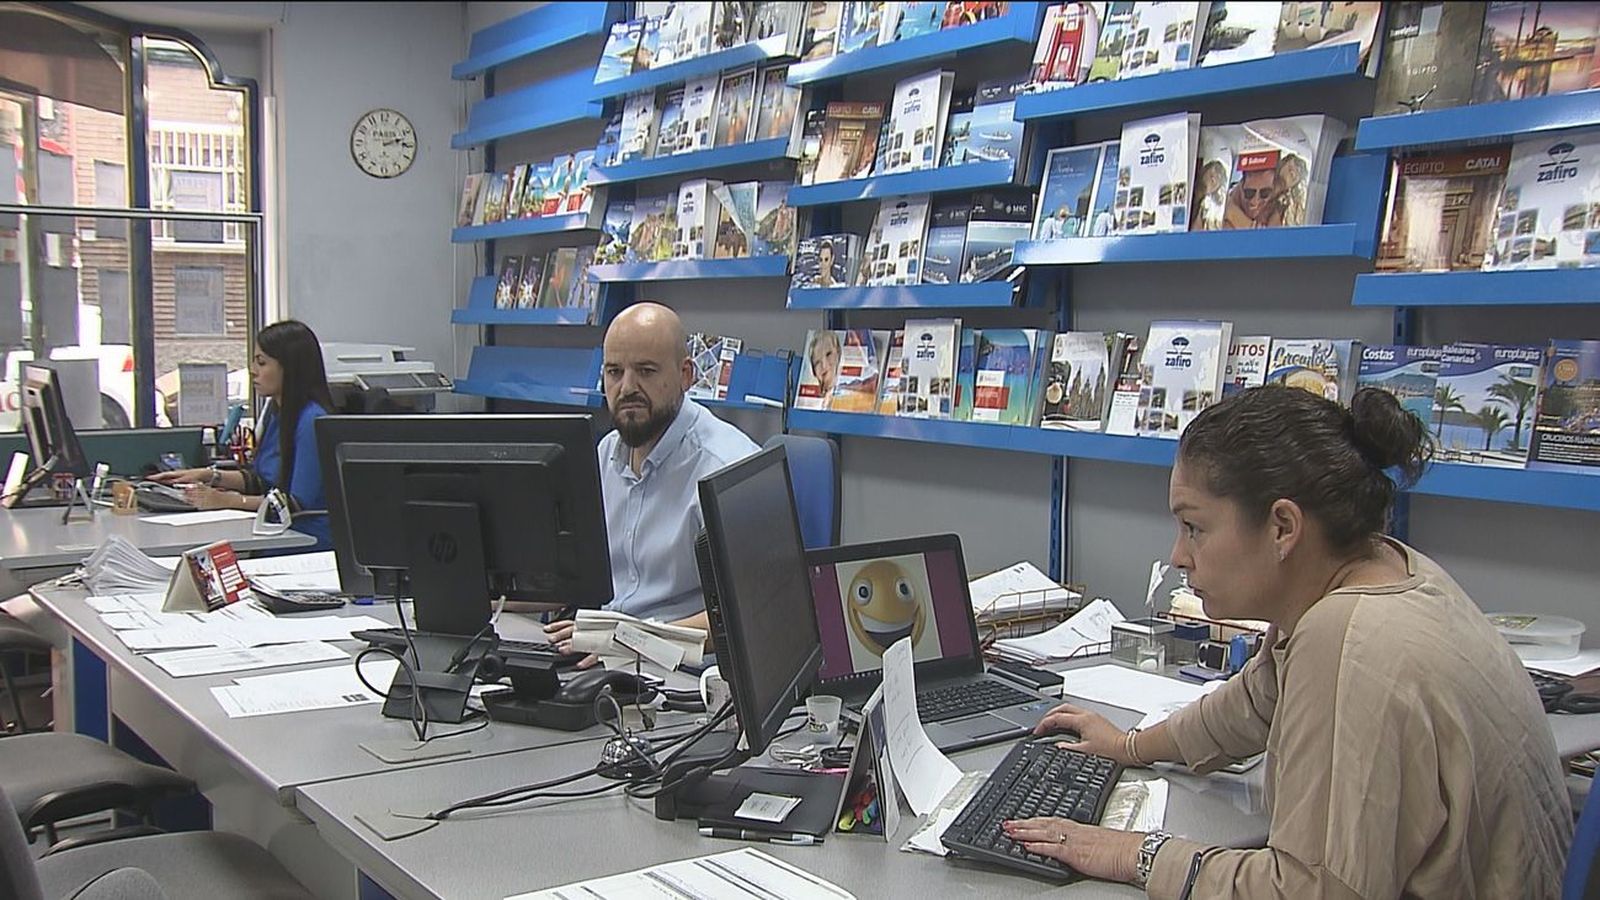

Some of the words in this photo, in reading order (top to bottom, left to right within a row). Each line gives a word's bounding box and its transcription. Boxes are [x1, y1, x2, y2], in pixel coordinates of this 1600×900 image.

[1140, 152, 1165, 165] zafiro
[1404, 161, 1445, 174] EGIPTO
[1465, 157, 1500, 170] CATAI
[1537, 166, 1578, 182] zafiro
[1013, 205, 1028, 213] MSC
[1362, 348, 1395, 360] Costas
[1441, 353, 1475, 364] Canarias
[1165, 355, 1192, 368] zafiro
